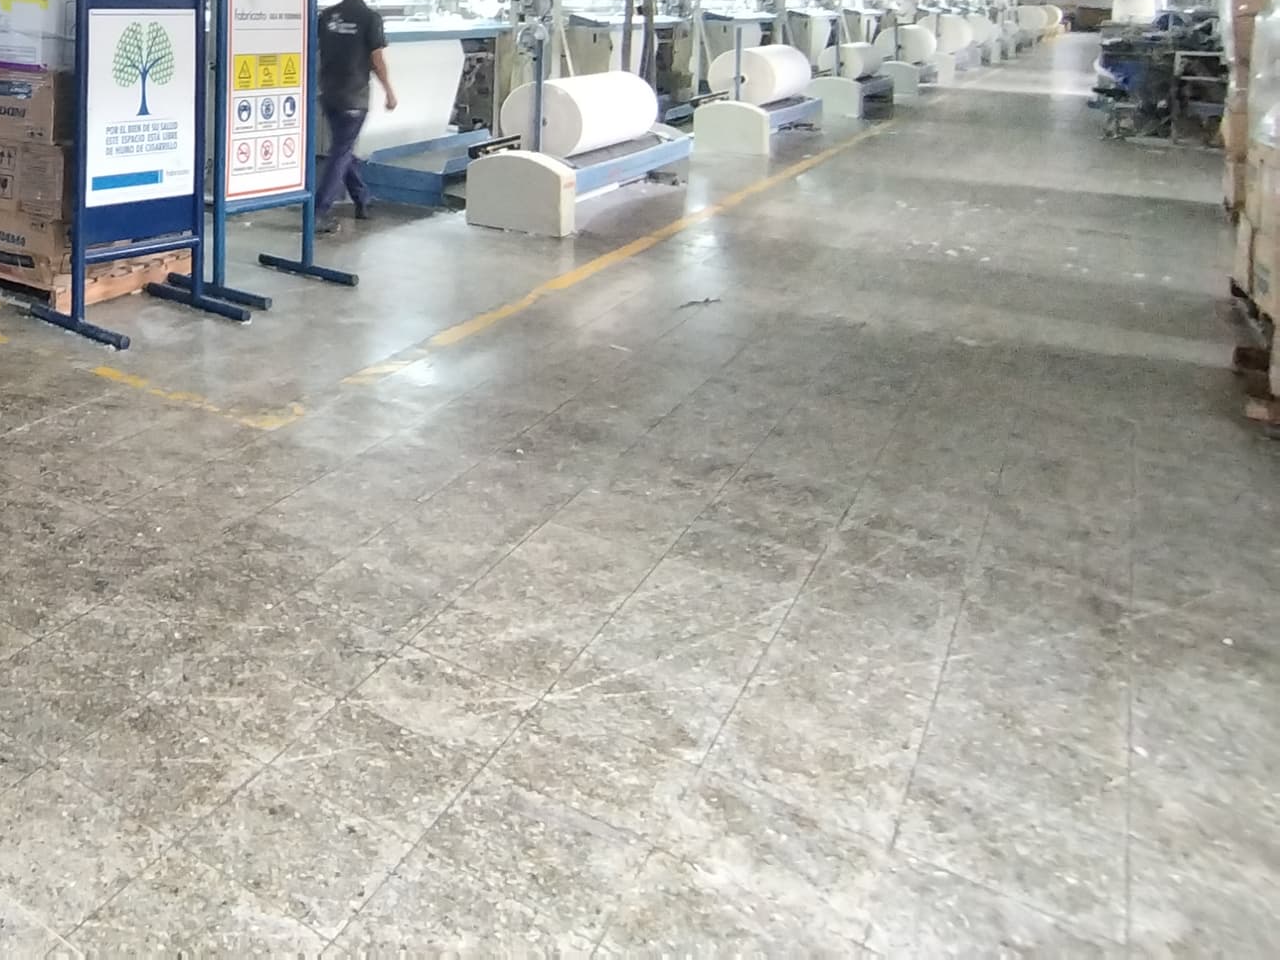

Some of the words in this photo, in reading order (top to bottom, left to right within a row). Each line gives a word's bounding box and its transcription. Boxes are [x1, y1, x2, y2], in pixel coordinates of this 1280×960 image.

[106, 126, 118, 135] POR
[120, 125, 126, 134] EL
[128, 124, 141, 133] BIEN
[143, 123, 150, 132] DE
[151, 122, 159, 131] SU
[160, 121, 178, 130] SALUD
[106, 136, 118, 145] ESTE
[121, 134, 145, 144] ESPACIO
[162, 131, 178, 140] LIBRE
[106, 147, 113, 155] DE
[115, 145, 134, 154] HUMO
[136, 144, 143, 152] DE
[145, 141, 178, 152] CIGARRILLO
